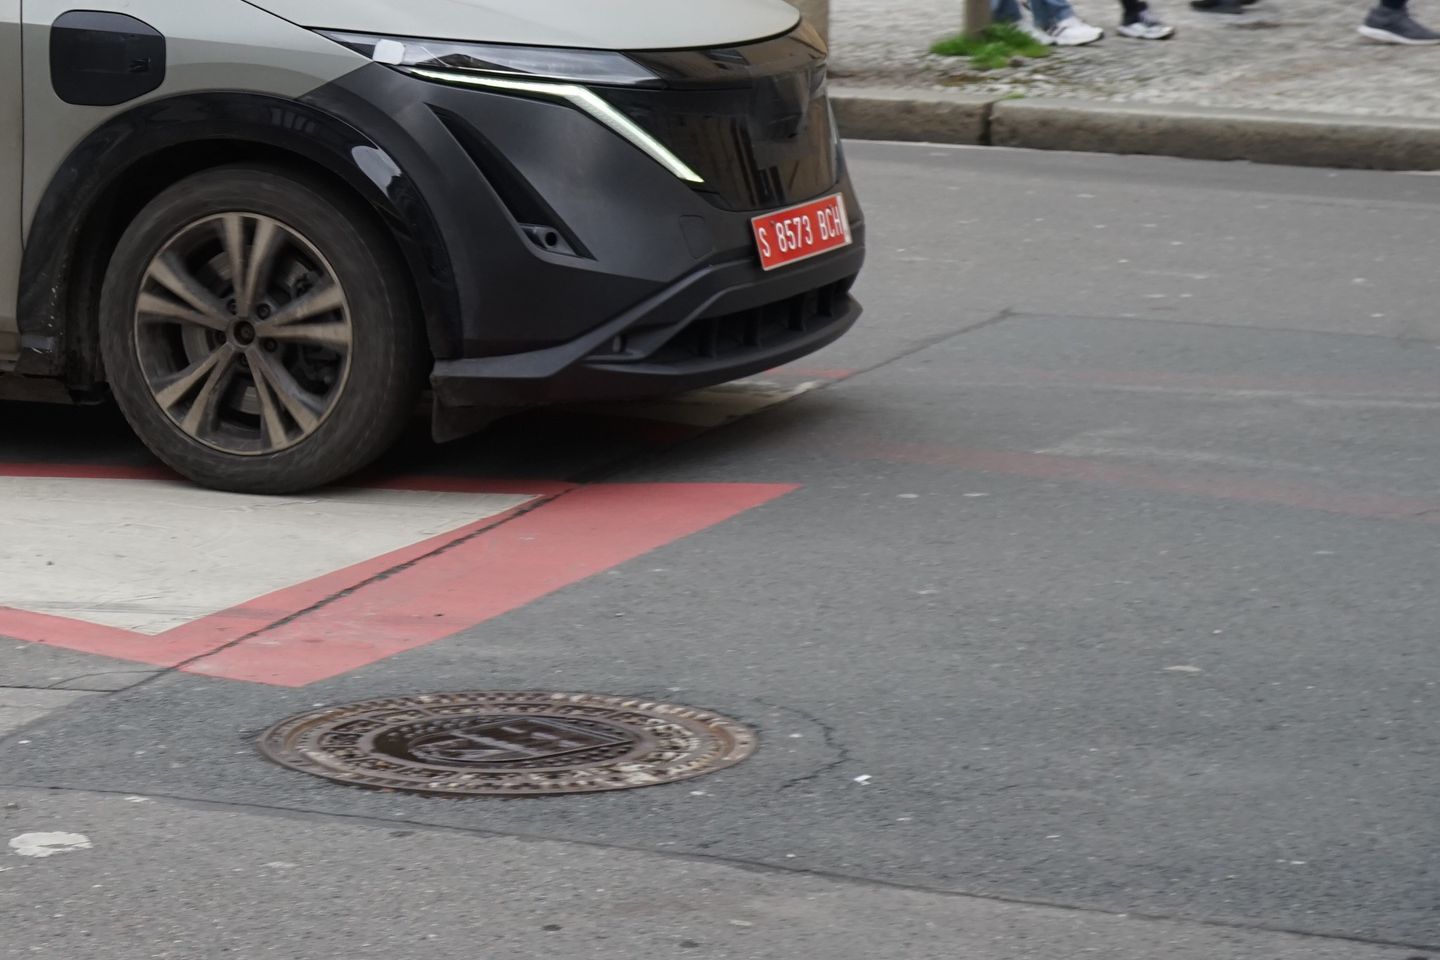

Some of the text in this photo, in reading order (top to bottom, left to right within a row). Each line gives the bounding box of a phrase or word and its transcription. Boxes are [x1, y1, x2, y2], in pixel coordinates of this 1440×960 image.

[758, 205, 844, 257] S 8573 BCH
